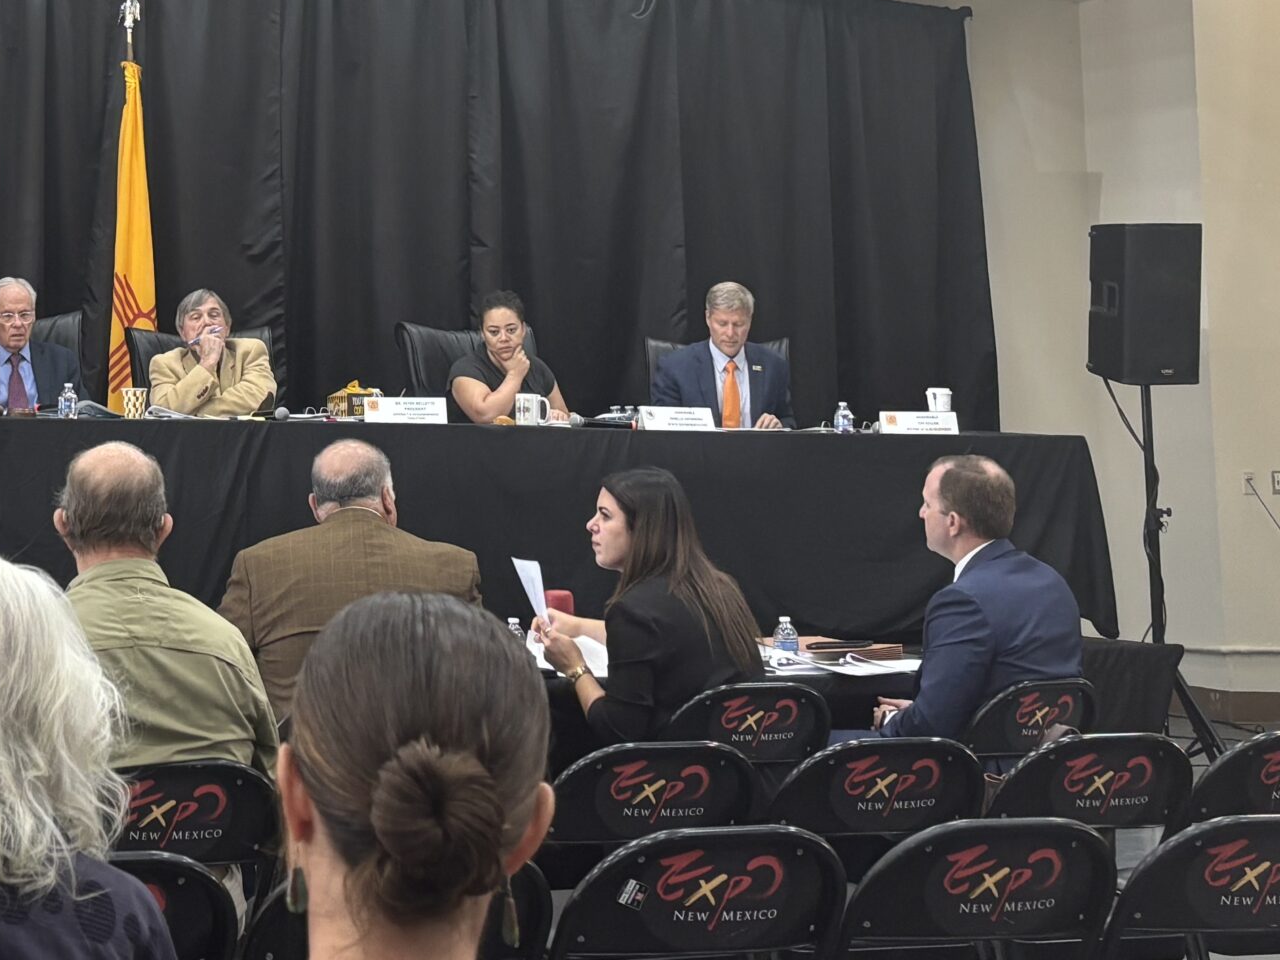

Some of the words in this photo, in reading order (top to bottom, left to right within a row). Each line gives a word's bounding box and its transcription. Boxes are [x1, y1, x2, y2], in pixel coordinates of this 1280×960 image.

[731, 734, 754, 742] NEW
[760, 731, 794, 741] MEXICO
[1022, 728, 1039, 736] NEW
[857, 801, 885, 811] NEW
[893, 798, 936, 809] MEXICO
[1075, 799, 1102, 808] NEW
[1109, 795, 1149, 807] MEXICO
[622, 807, 652, 817] NEW
[660, 807, 704, 817] MEXICO
[129, 830, 161, 841] NEW
[171, 828, 223, 840] MEXICO
[959, 902, 993, 914] NEW
[1003, 898, 1056, 913] MEXICO
[1220, 895, 1254, 906] NEW
[672, 910, 710, 922] NEW
[721, 908, 778, 922] MEXICO
